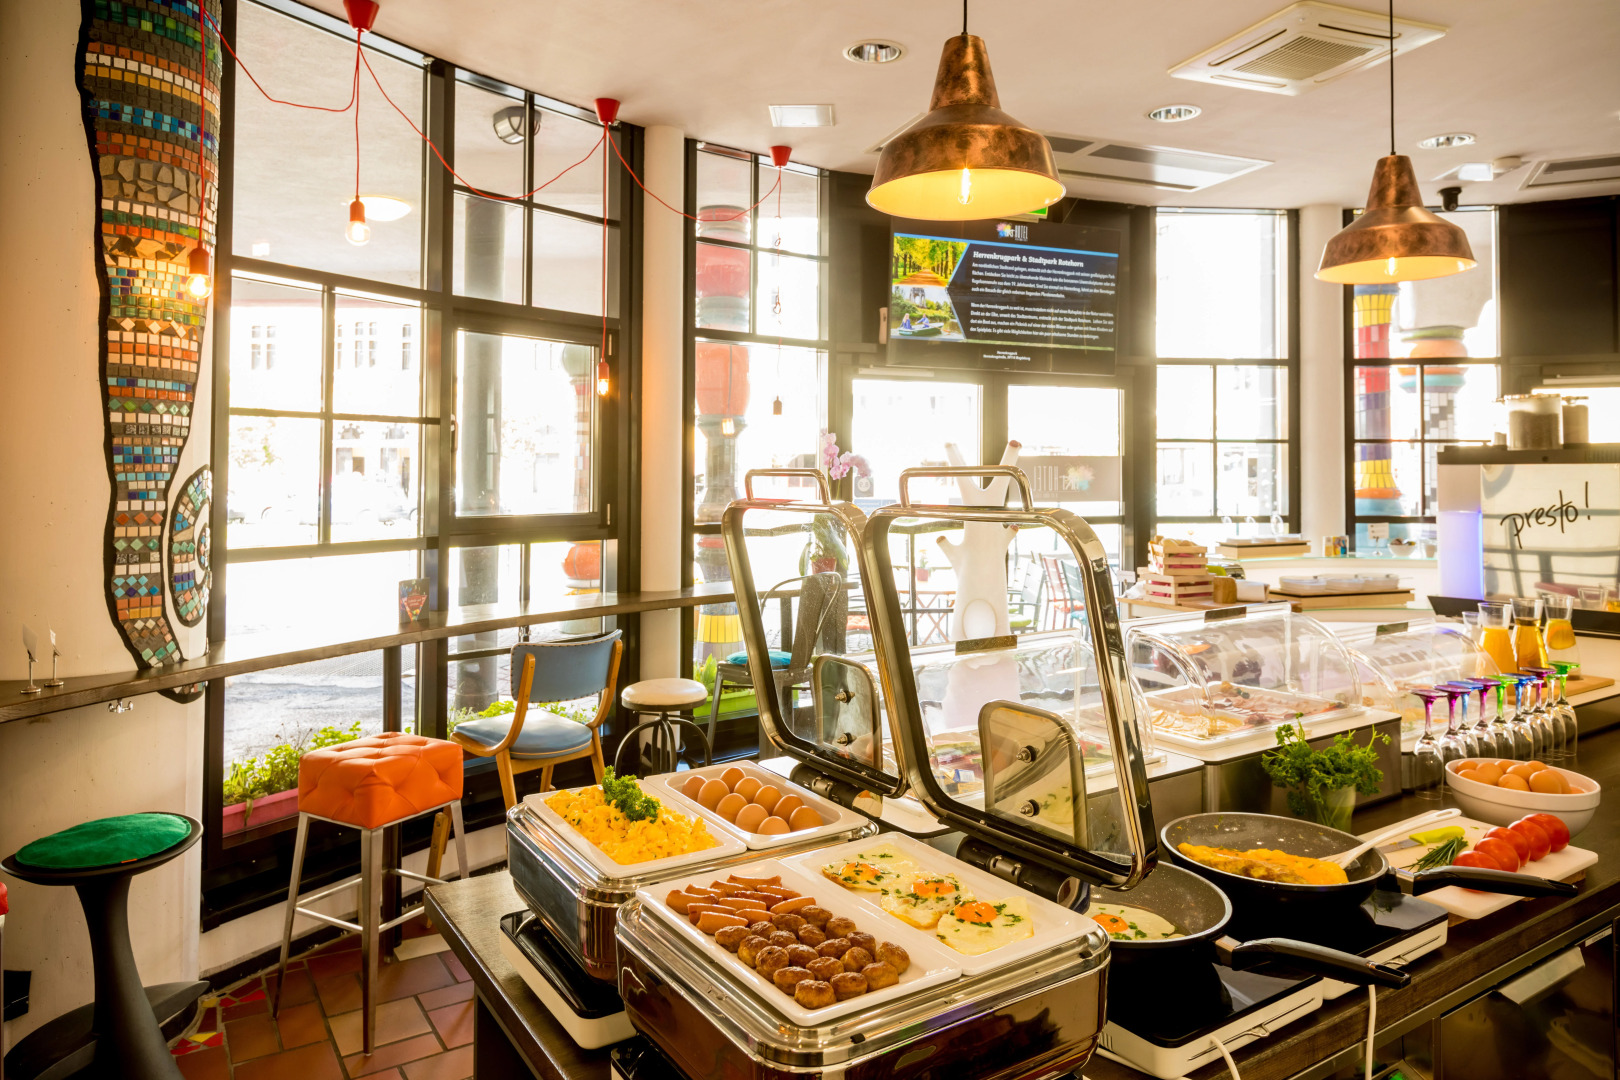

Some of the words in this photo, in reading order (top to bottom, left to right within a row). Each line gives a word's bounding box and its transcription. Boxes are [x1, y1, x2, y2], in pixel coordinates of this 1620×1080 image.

[973, 251, 1021, 262] Herrenkrugpark
[1028, 256, 1057, 266] Stadtpark
[1058, 258, 1084, 268] Rotehorn
[1499, 481, 1591, 549] presto!
